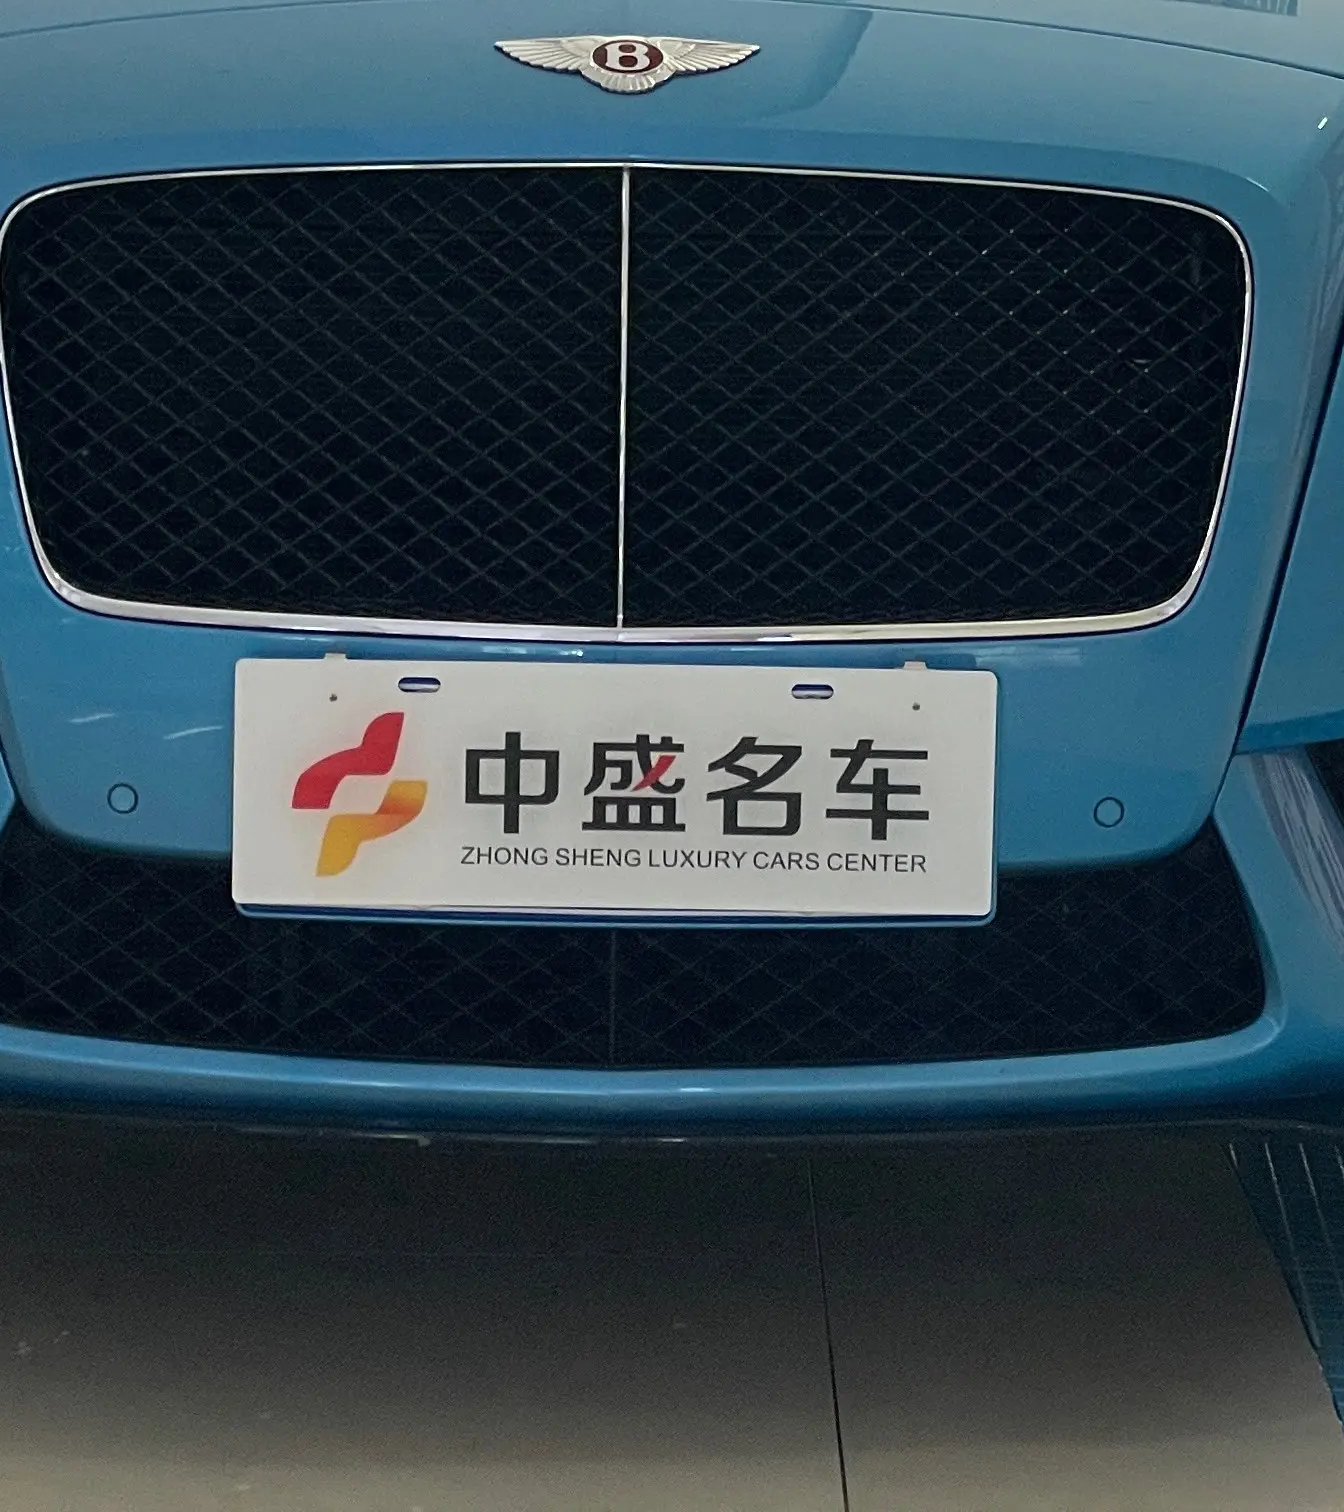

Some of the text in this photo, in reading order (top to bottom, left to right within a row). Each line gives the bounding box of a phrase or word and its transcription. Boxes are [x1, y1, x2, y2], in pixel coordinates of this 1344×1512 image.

[606, 42, 650, 71] B
[464, 731, 930, 841] 中盛名车
[461, 845, 927, 874] ZHONG SHENG LUXURY CARS CENTER
